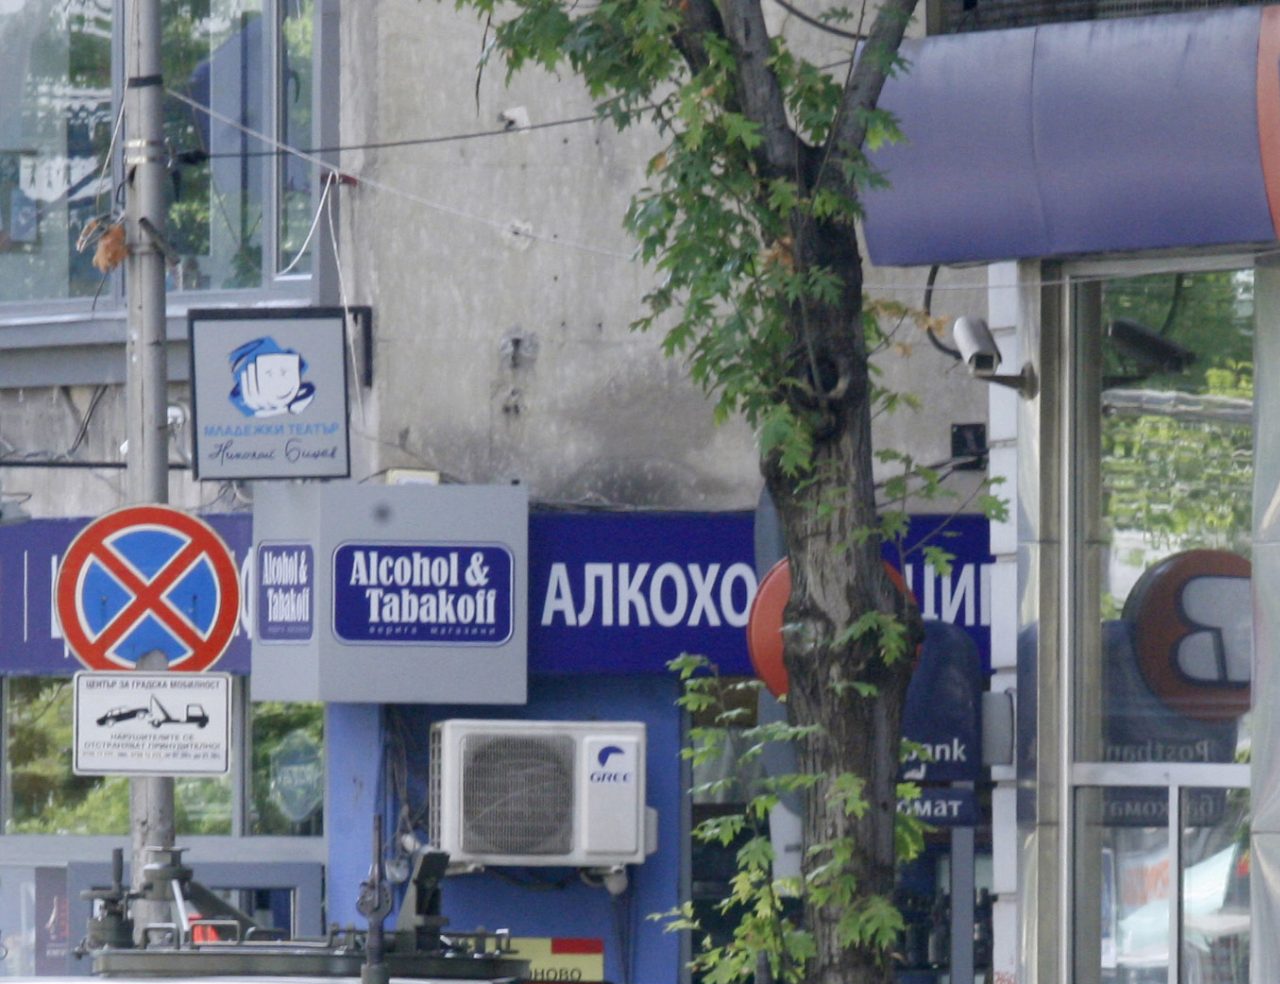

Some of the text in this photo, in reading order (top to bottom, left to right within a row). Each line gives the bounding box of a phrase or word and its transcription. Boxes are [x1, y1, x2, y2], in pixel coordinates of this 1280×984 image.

[262, 550, 308, 586] Alcohol &
[349, 551, 490, 586] Alcohol &
[267, 587, 310, 622] Tabakoff
[366, 588, 497, 624] Tabakoff
[541, 562, 758, 628] АЛКОХО
